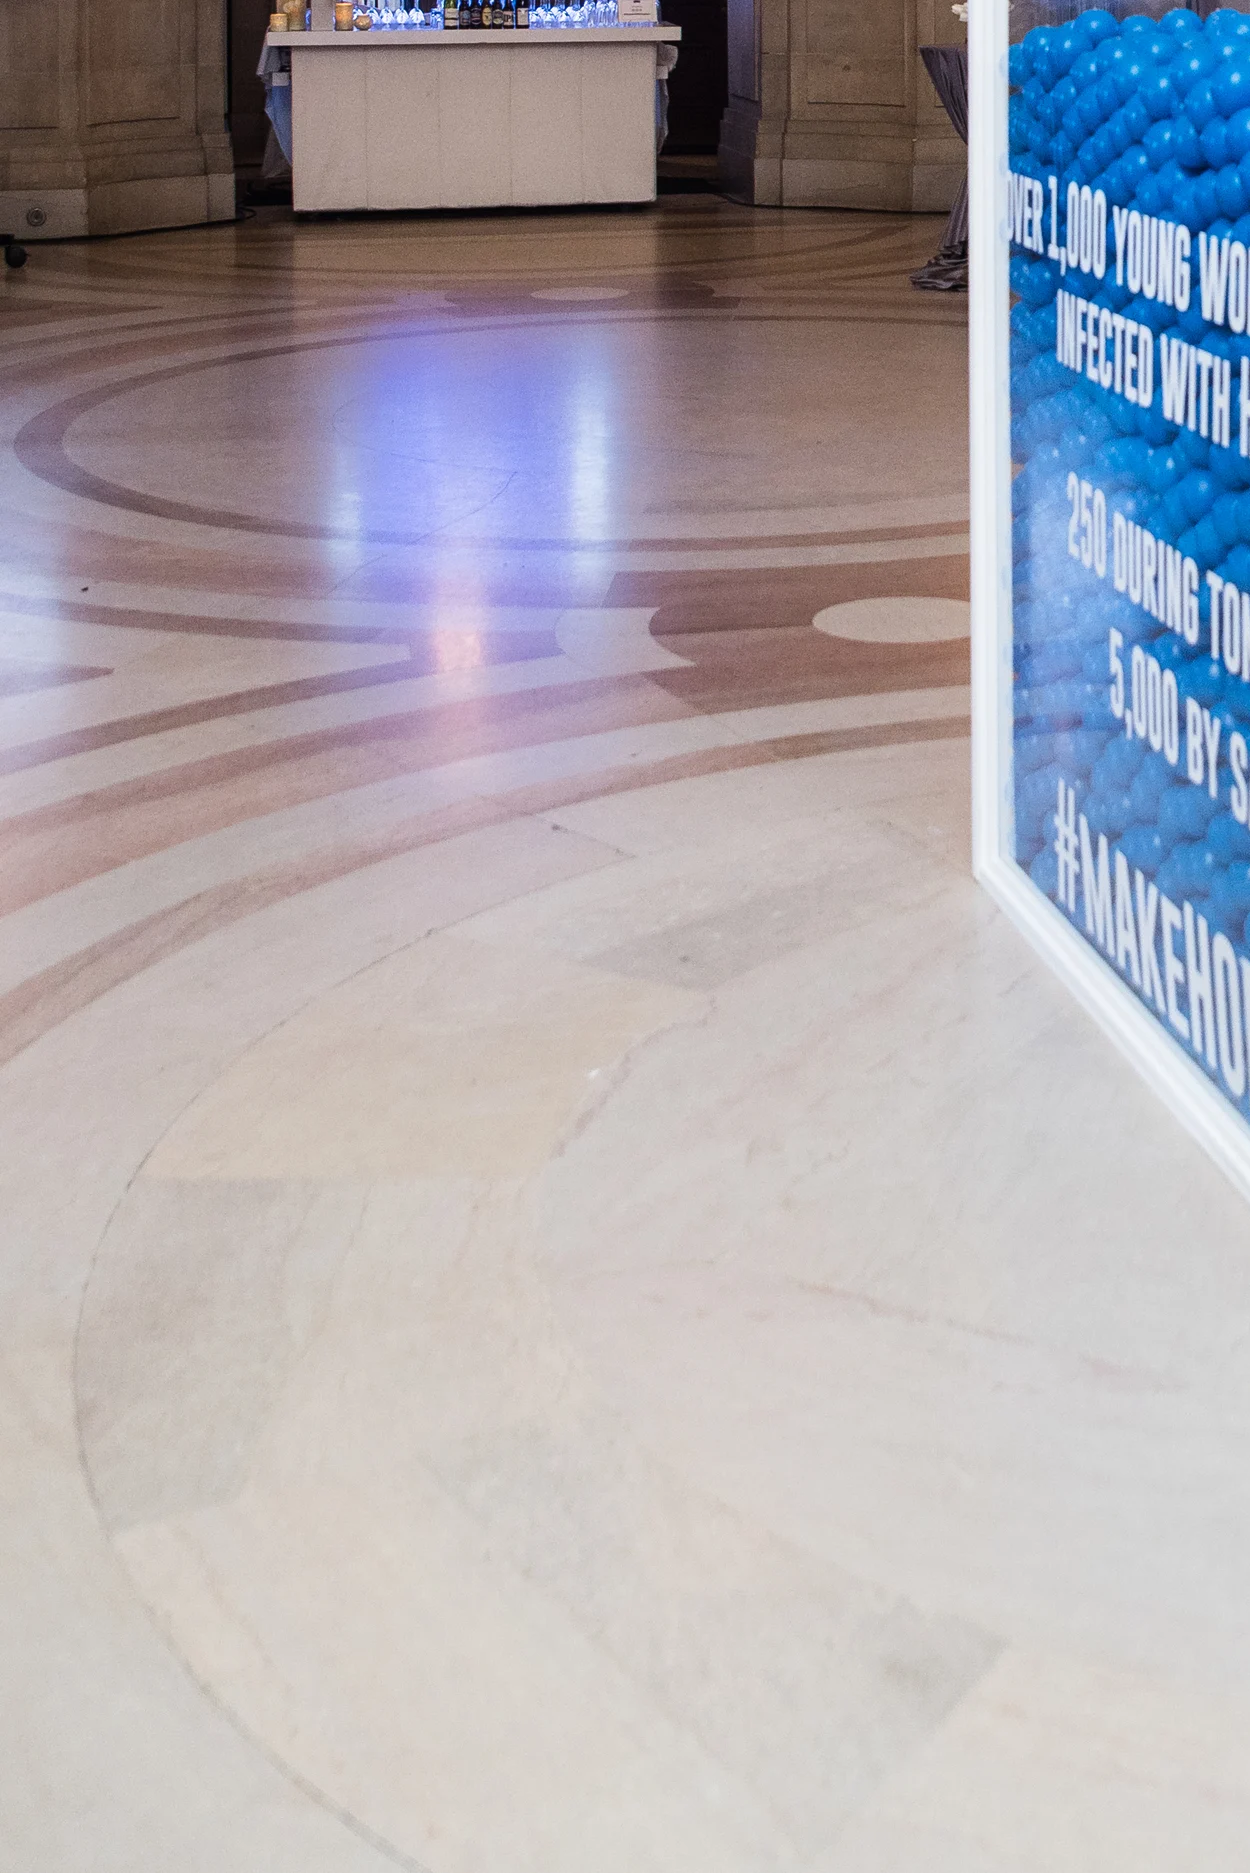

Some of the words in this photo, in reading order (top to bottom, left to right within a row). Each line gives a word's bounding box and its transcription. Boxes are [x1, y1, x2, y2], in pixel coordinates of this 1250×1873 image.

[1048, 175, 1107, 278] 1,000
[1113, 207, 1191, 312] YOUNG
[1056, 288, 1153, 408] INFECTED
[1161, 335, 1230, 447] WITH
[1066, 472, 1107, 579] 250
[1112, 510, 1200, 645] DURING
[1108, 628, 1179, 765] 5,000
[1186, 697, 1221, 798] BY
